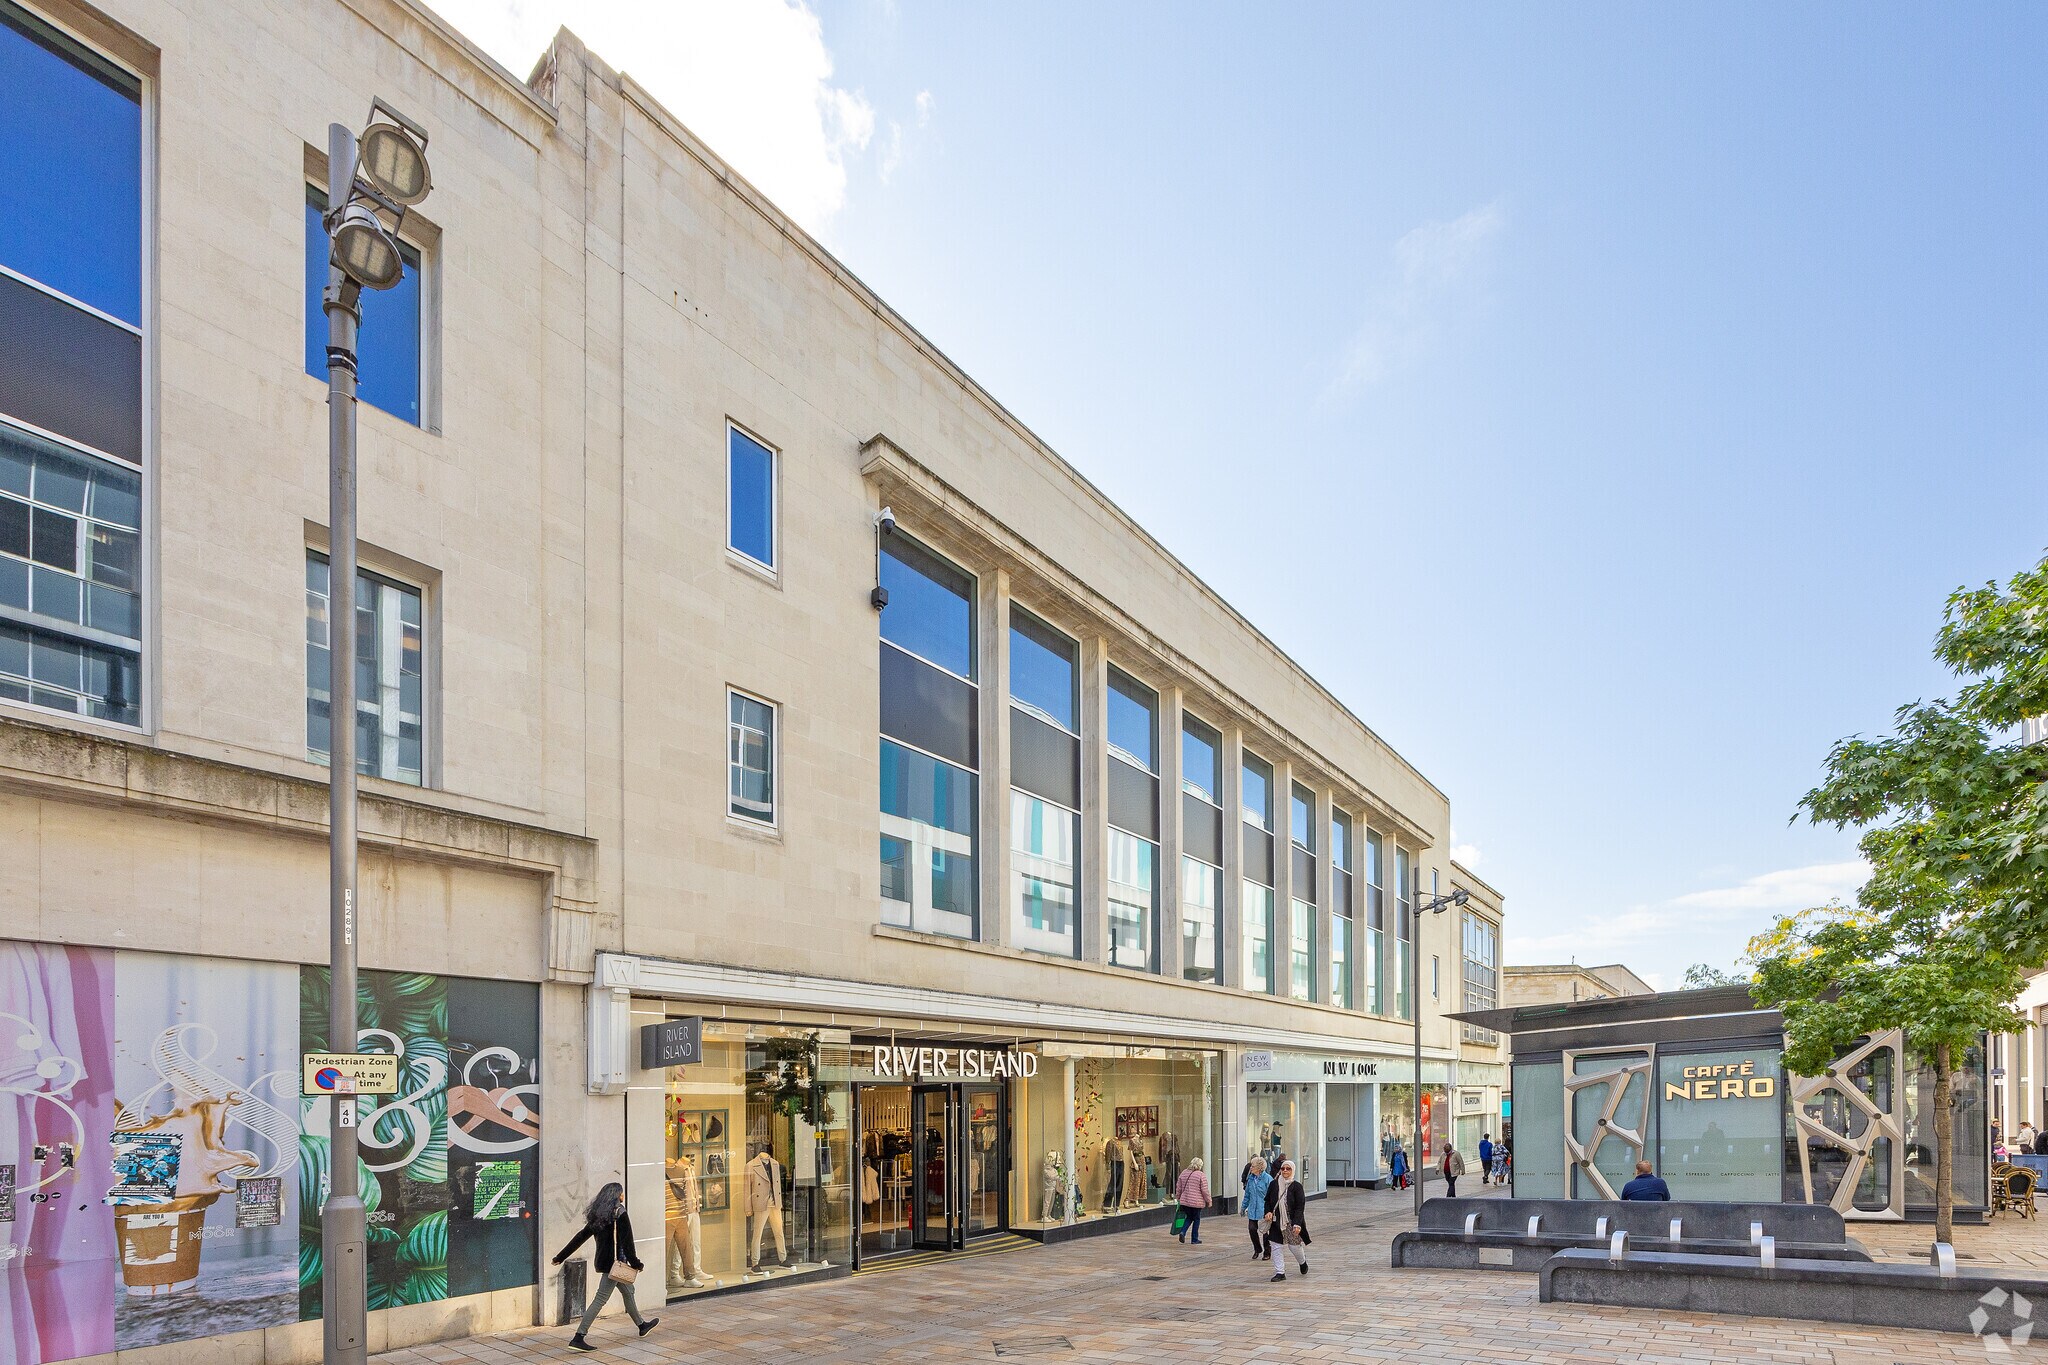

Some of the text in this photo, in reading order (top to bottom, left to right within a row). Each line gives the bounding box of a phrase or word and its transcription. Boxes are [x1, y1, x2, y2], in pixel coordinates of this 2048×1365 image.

[666, 1026, 689, 1042] RIVER
[663, 1042, 692, 1060] ISLAND
[308, 1057, 393, 1066] Pedestrian Zone
[873, 1046, 1038, 1078] RIVER ISLAND
[1245, 1061, 1269, 1069] LOOK
[1323, 1061, 1377, 1076] NEW LOOK
[1682, 1060, 1754, 1078] CAFFÈ
[354, 1071, 387, 1080] At any
[1665, 1077, 1775, 1101] NERO
[1464, 1097, 1480, 1105] BURTON
